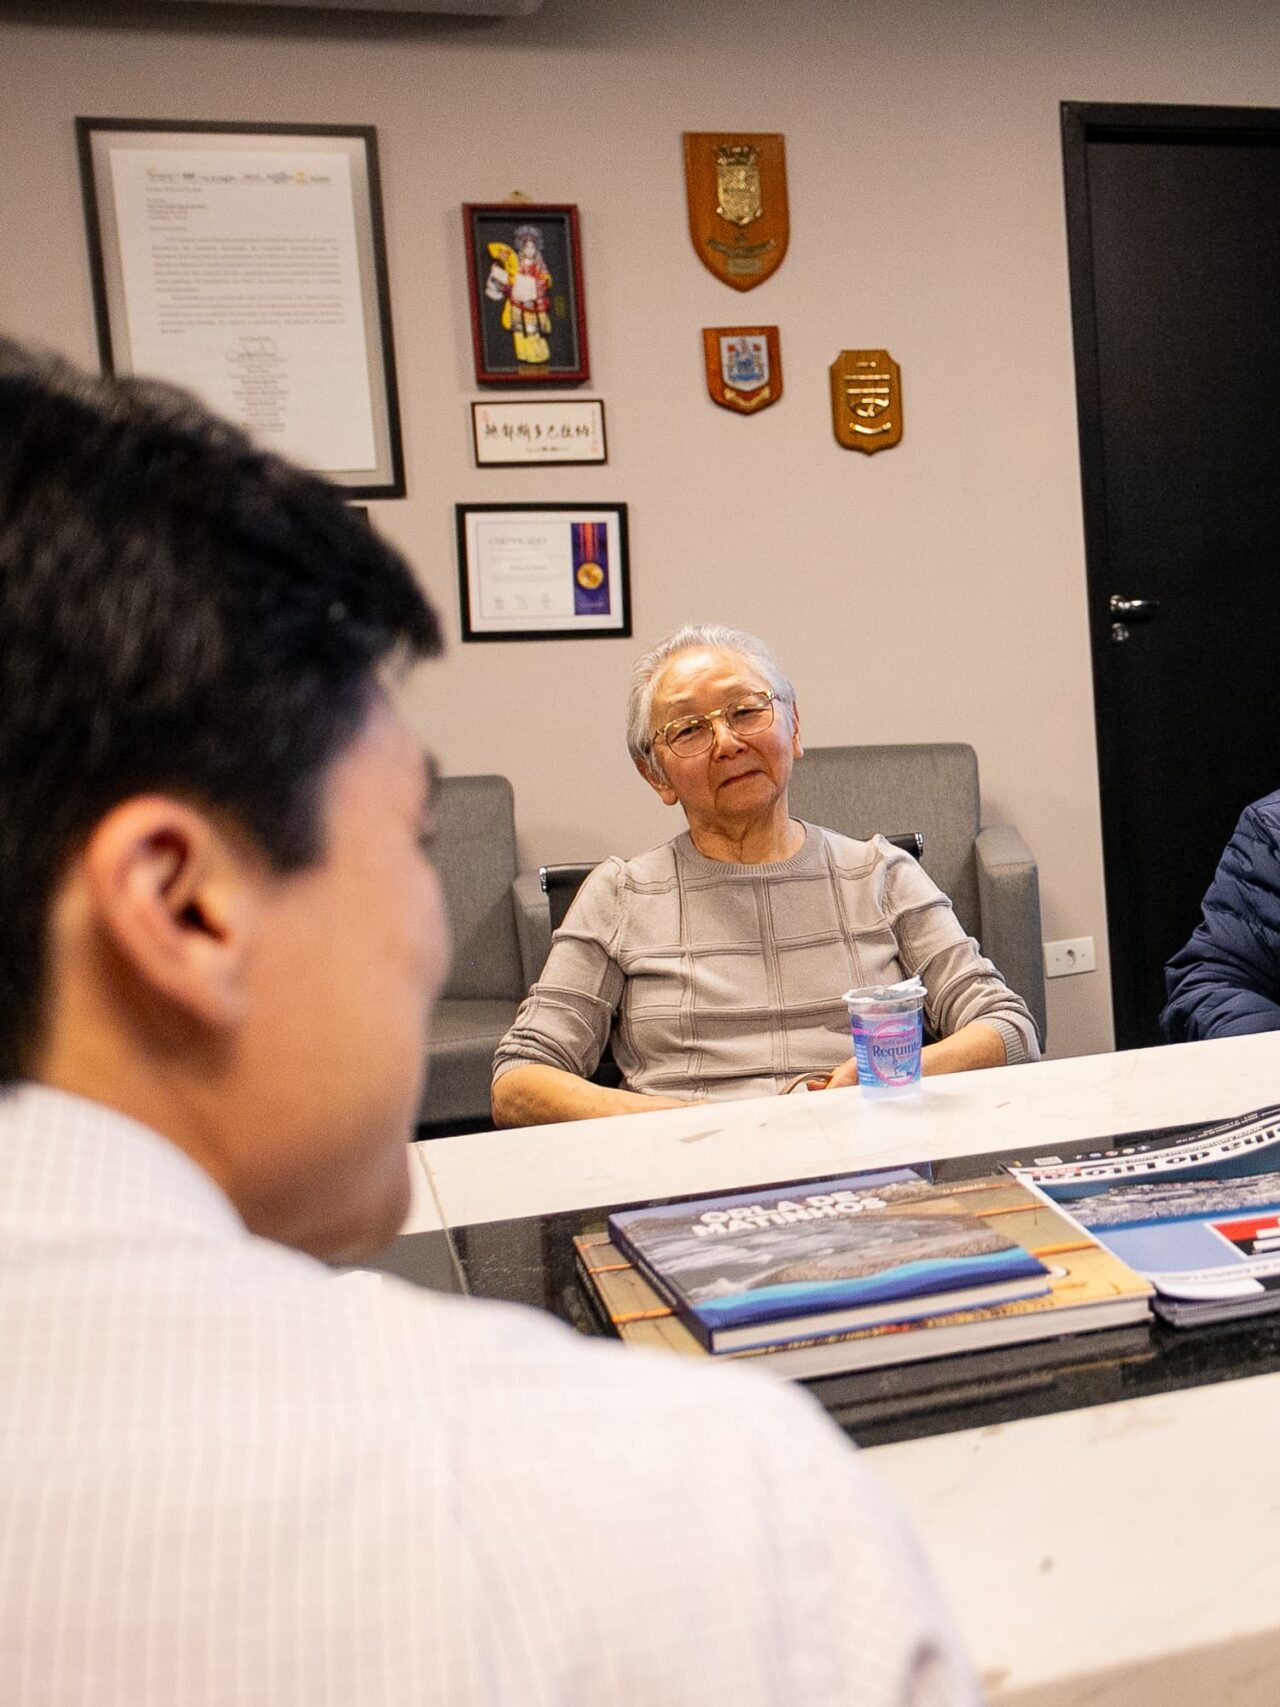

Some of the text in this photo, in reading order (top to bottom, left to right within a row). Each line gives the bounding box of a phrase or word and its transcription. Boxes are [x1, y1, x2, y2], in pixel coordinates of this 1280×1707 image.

[1165, 1151, 1211, 1164] do
[691, 1197, 887, 1237] MATINHOS
[700, 1190, 861, 1224] ORLA DE
